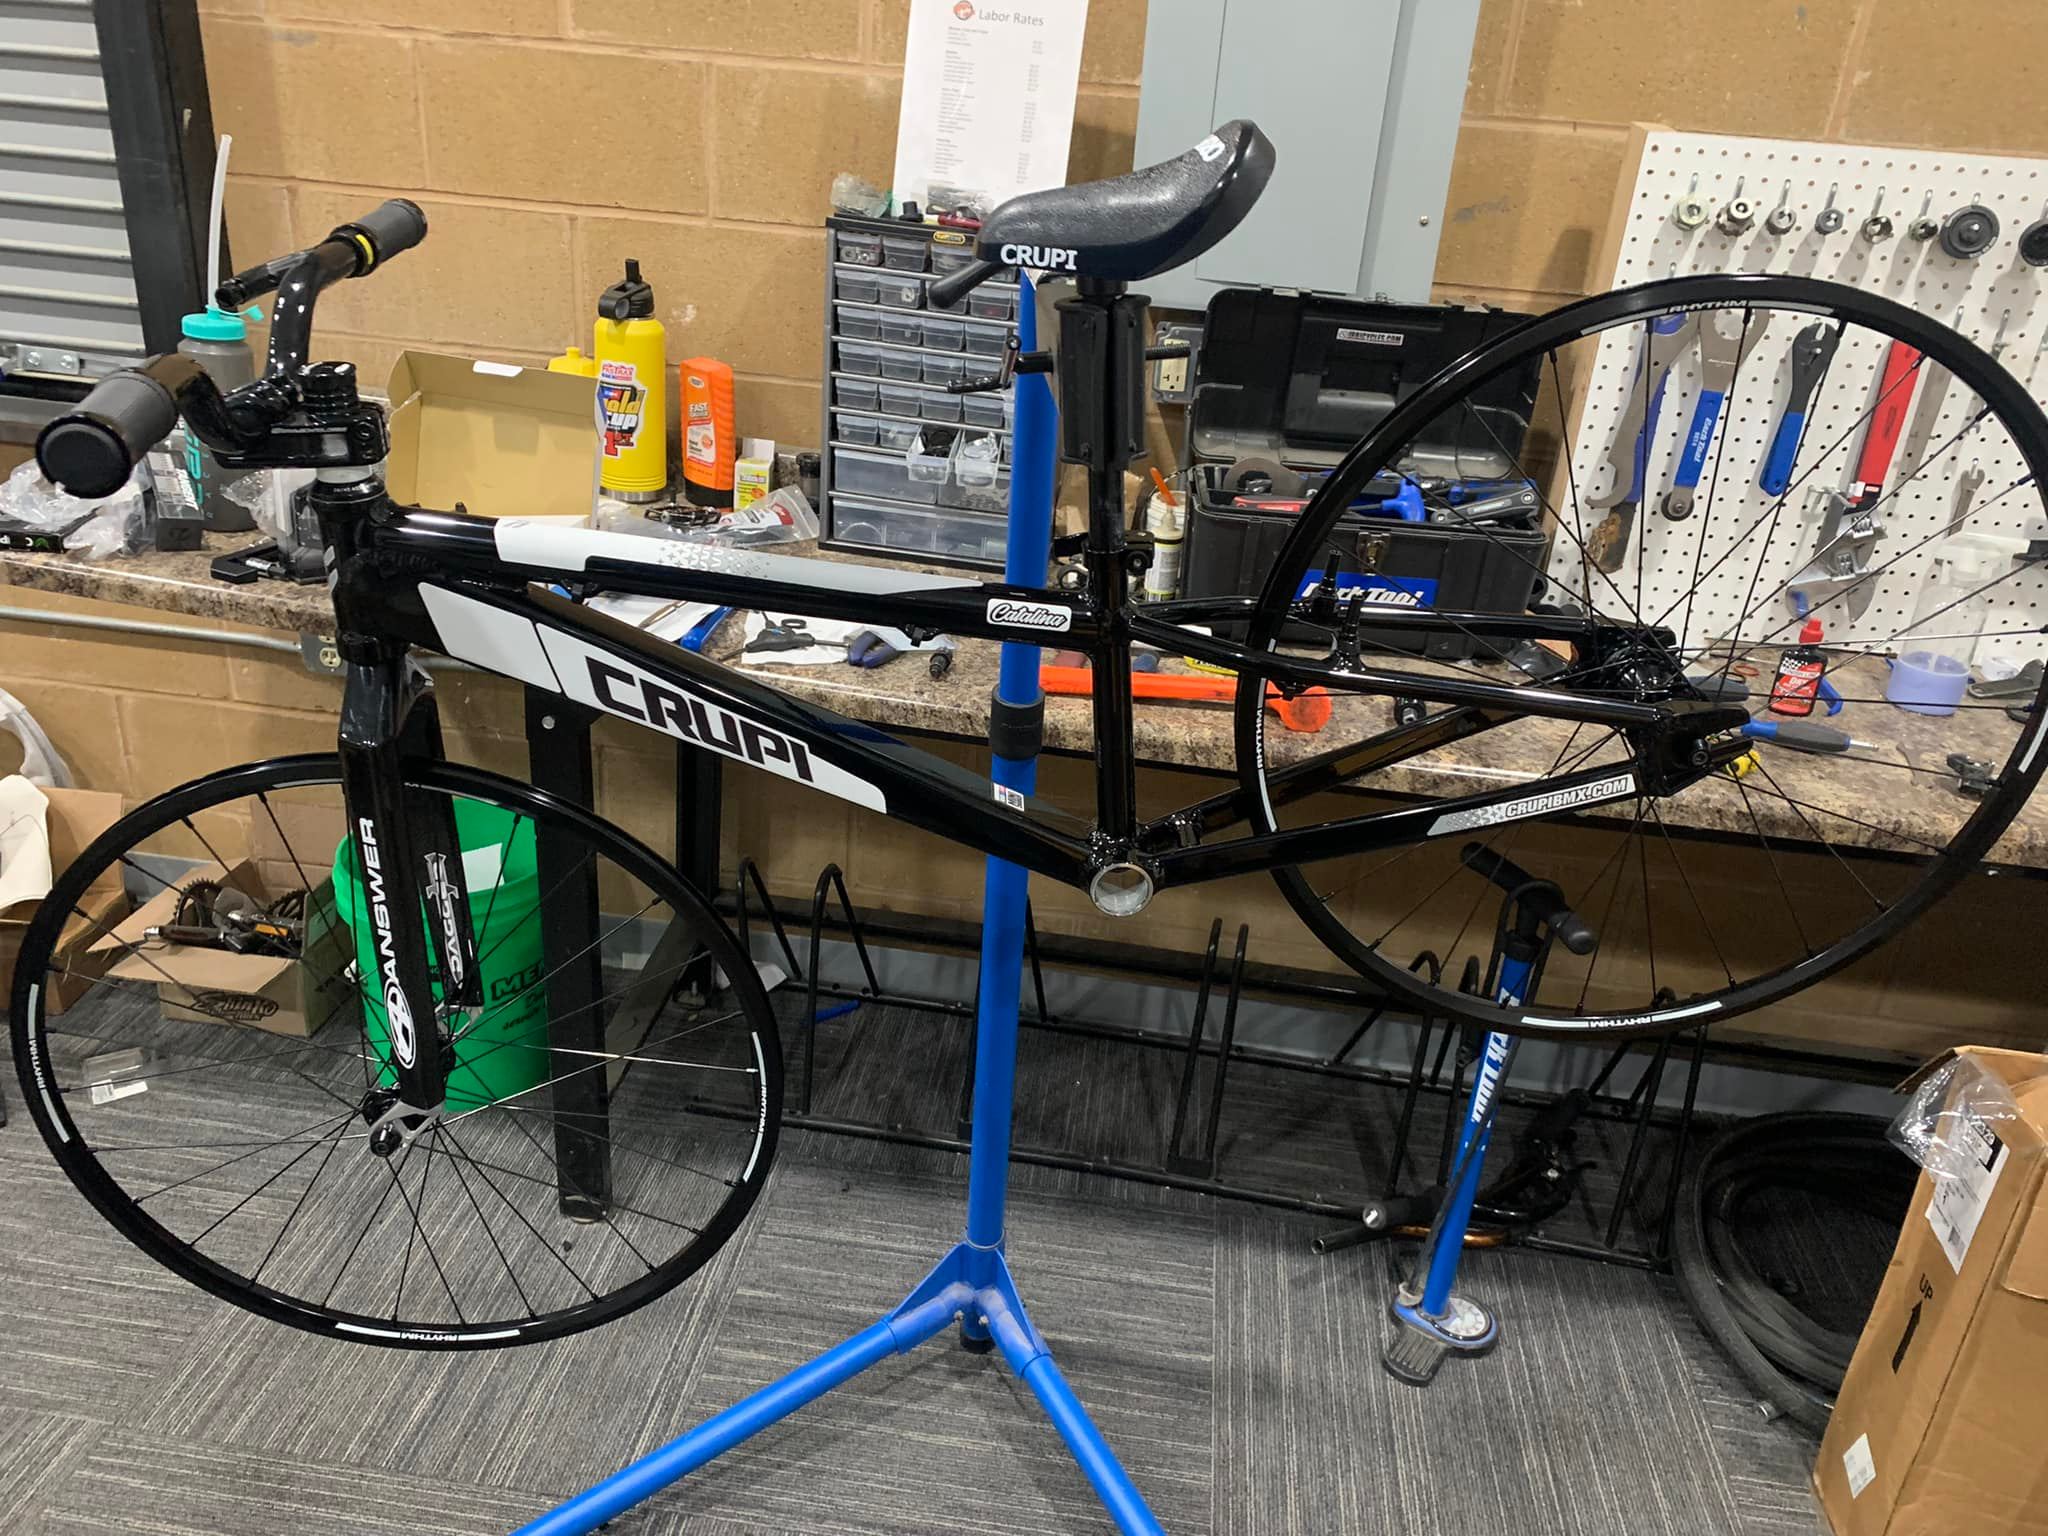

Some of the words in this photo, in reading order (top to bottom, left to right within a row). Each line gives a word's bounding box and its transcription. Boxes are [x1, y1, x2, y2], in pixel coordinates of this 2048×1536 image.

[979, 9, 1010, 22] Labor
[1013, 12, 1044, 26] Rates
[1000, 243, 1078, 270] CRUPI
[1669, 300, 1747, 313] RHYTHM
[990, 603, 1067, 628] Catalina
[585, 656, 814, 783] CRUPI
[1506, 777, 1628, 817] CRUPIBMX.COM
[359, 817, 399, 985] ANSWER
[1590, 1016, 1651, 1028] RHYTHM
[1919, 1273, 1934, 1300] UP
[401, 1332, 457, 1341] RHYTHM
